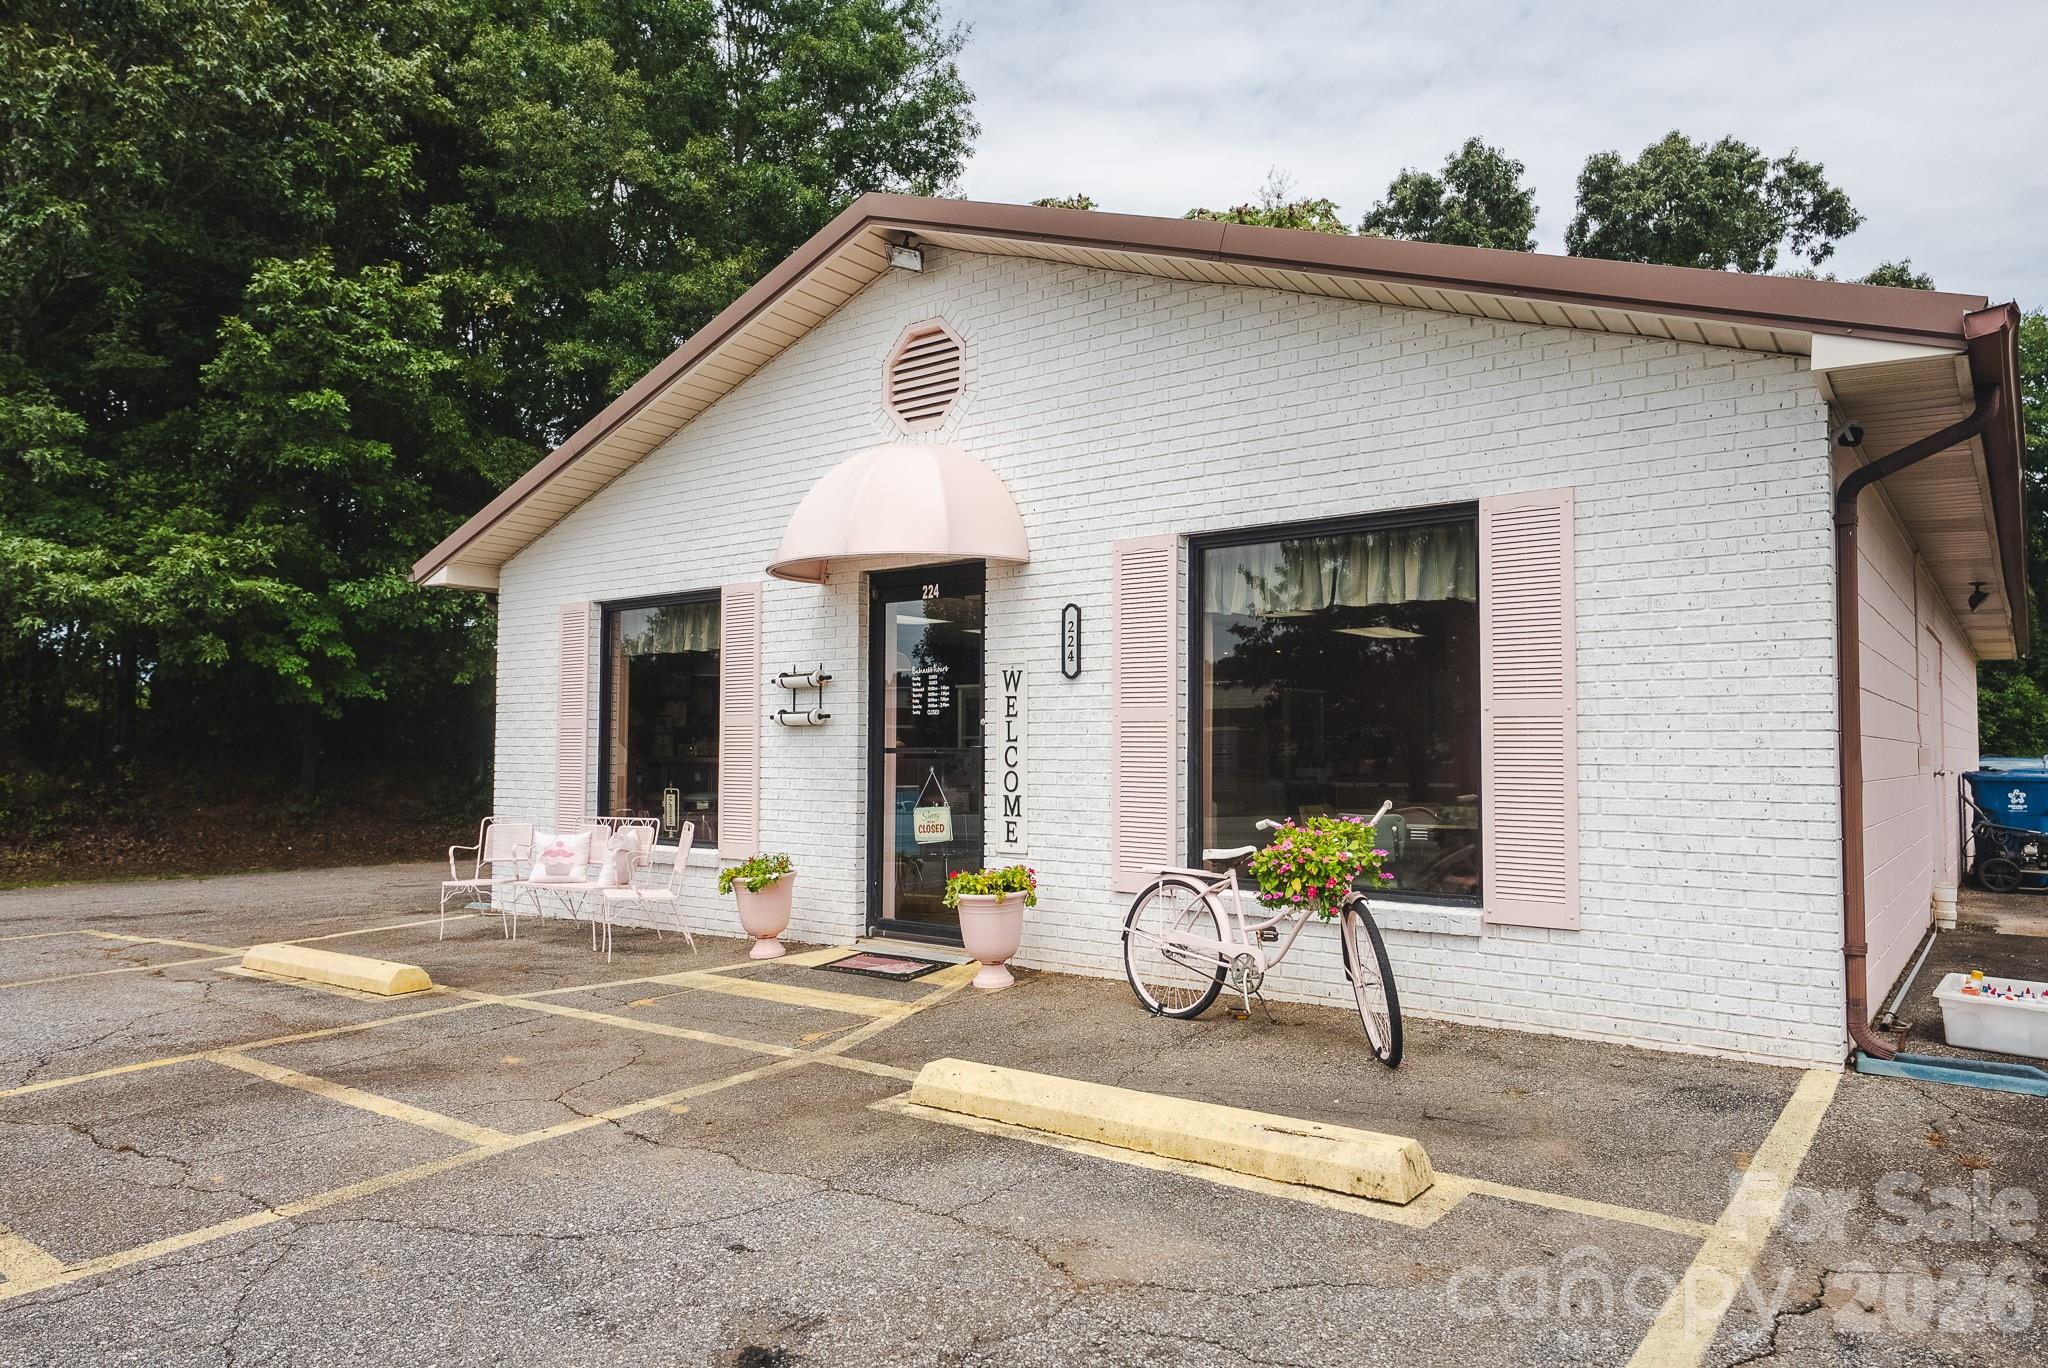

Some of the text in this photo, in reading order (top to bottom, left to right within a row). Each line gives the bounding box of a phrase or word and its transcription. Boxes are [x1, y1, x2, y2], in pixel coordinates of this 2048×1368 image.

[922, 583, 940, 600] 224
[1066, 620, 1076, 662] 224
[1002, 669, 1023, 843] WELCOME
[918, 822, 945, 834] CLOSED
